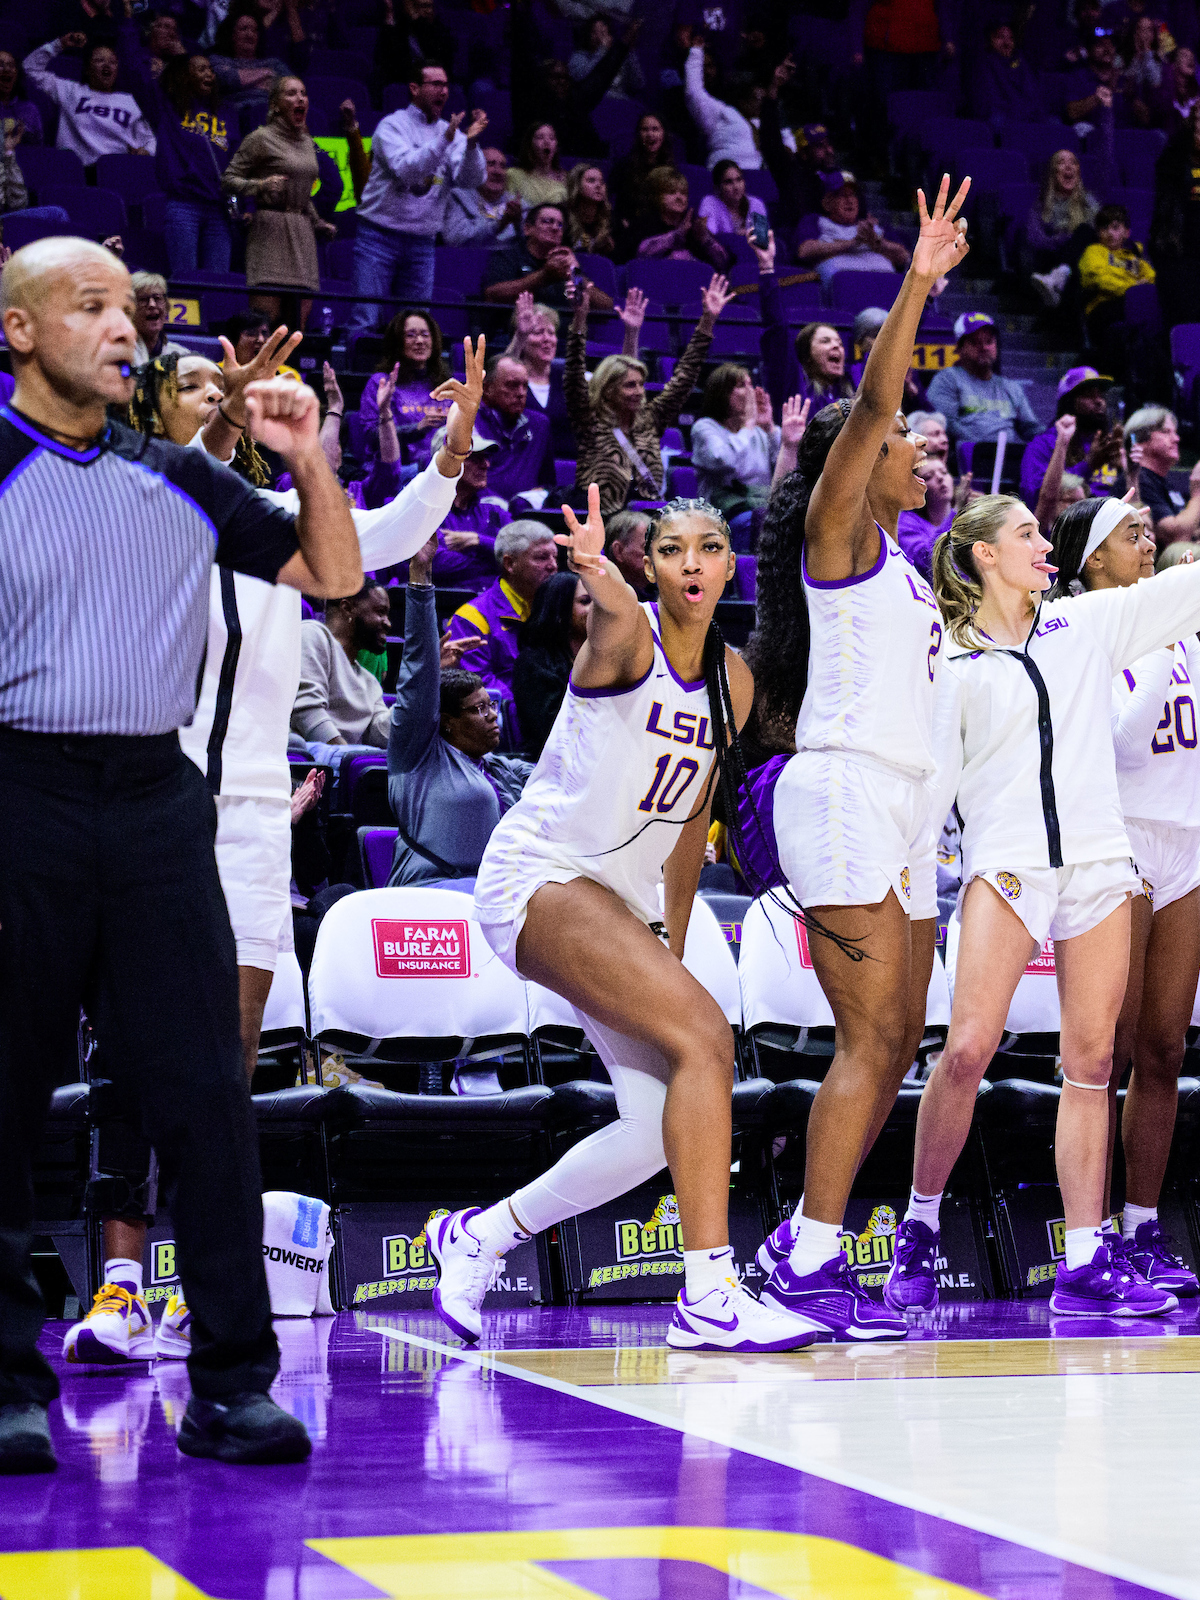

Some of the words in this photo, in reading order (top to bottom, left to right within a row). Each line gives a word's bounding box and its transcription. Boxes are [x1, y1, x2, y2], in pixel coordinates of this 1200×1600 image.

[75, 97, 131, 128] LSU
[180, 110, 227, 138] LSU
[166, 303, 188, 324] 2
[905, 573, 940, 612] LS
[1035, 616, 1069, 638] LSU
[1151, 695, 1198, 755] 20
[637, 752, 700, 814] 10
[403, 927, 458, 941] FARM
[383, 941, 460, 956] BUREAU
[398, 961, 460, 970] INSURANCE
[301, 1199, 314, 1243] OWERADE
[621, 1222, 684, 1256] Ben
[840, 1233, 896, 1265] Ben
[590, 1263, 639, 1288] KEEPS
[641, 1261, 685, 1276] PESTS
[857, 1273, 889, 1287] PEST
[1027, 1263, 1057, 1286] KEE
[354, 1279, 407, 1303] KEEPS
[407, 1276, 437, 1291] PES
